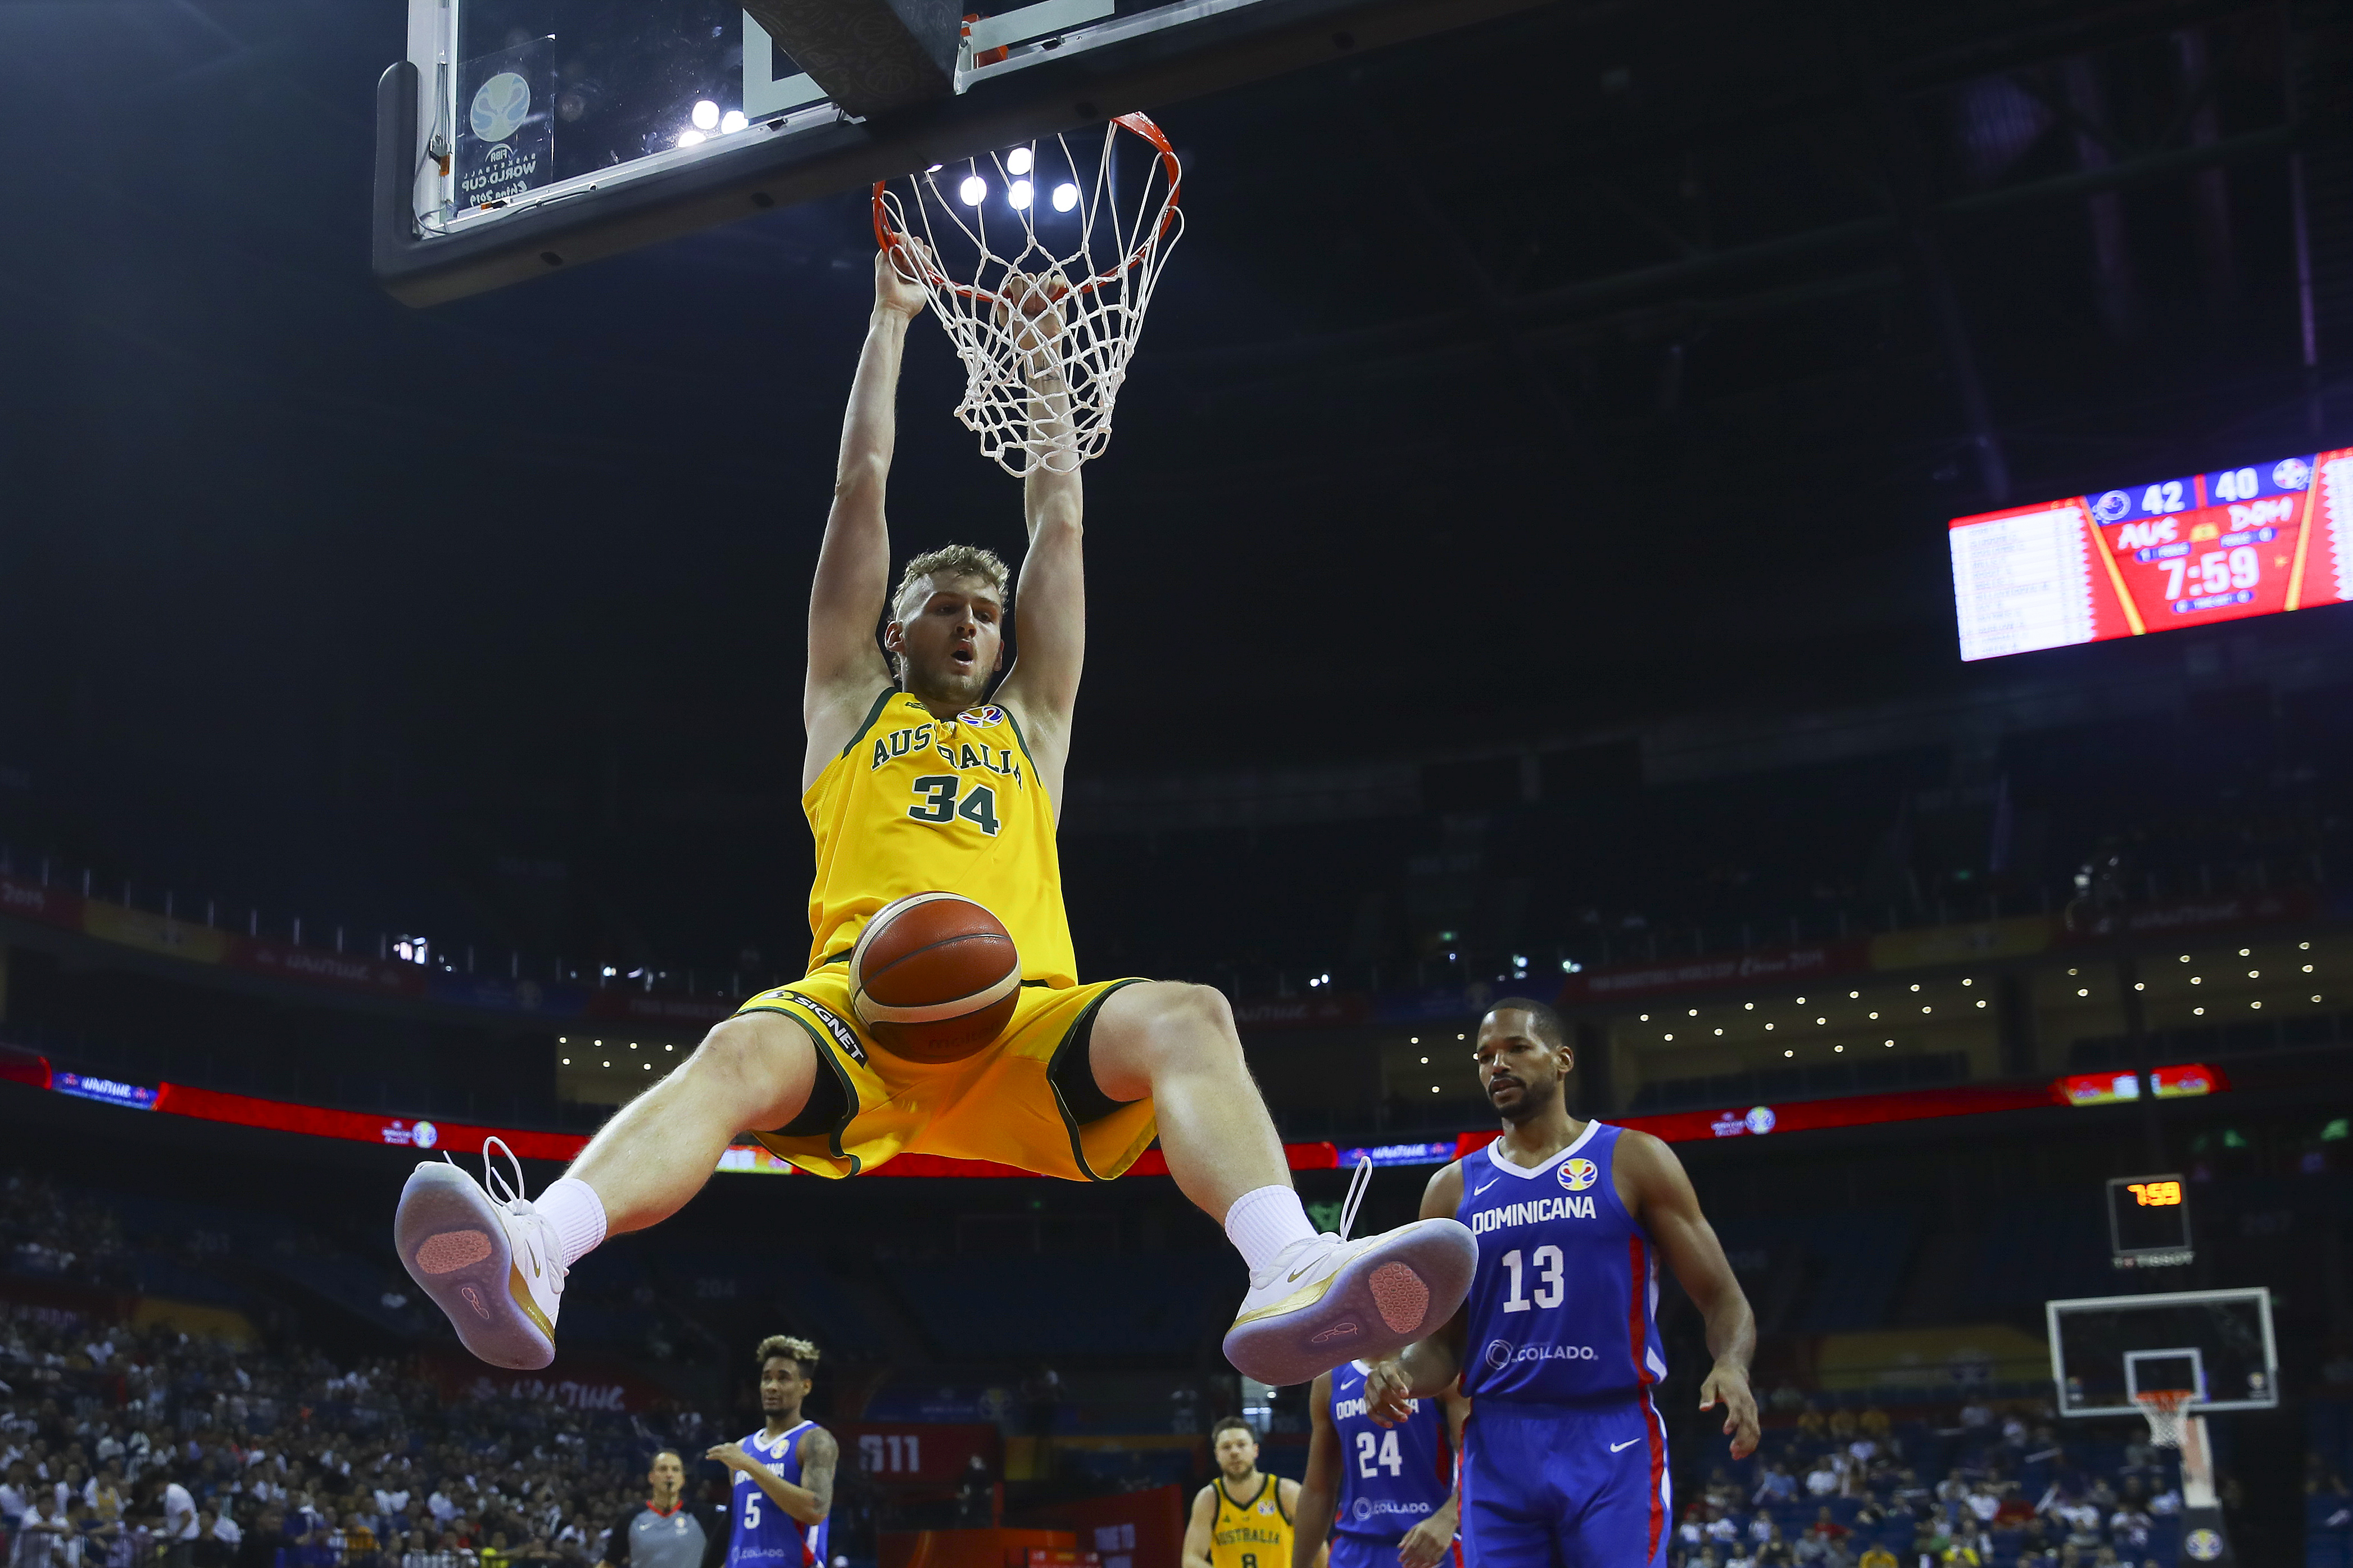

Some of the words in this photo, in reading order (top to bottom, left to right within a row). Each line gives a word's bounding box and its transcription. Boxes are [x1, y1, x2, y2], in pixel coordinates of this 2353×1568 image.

[2142, 481, 2185, 515] 42
[2215, 467, 2259, 502] 40
[2228, 497, 2294, 531] DOM
[2158, 546, 2260, 600] 7:59
[906, 774, 1001, 837] 34
[795, 996, 864, 1060] SIGNET
[1472, 1196, 1597, 1236] DOMINICANA
[1502, 1244, 1565, 1314] 13
[1517, 1345, 1594, 1362] COLLADO
[1356, 1430, 1403, 1479] 24
[743, 1492, 763, 1529] 5
